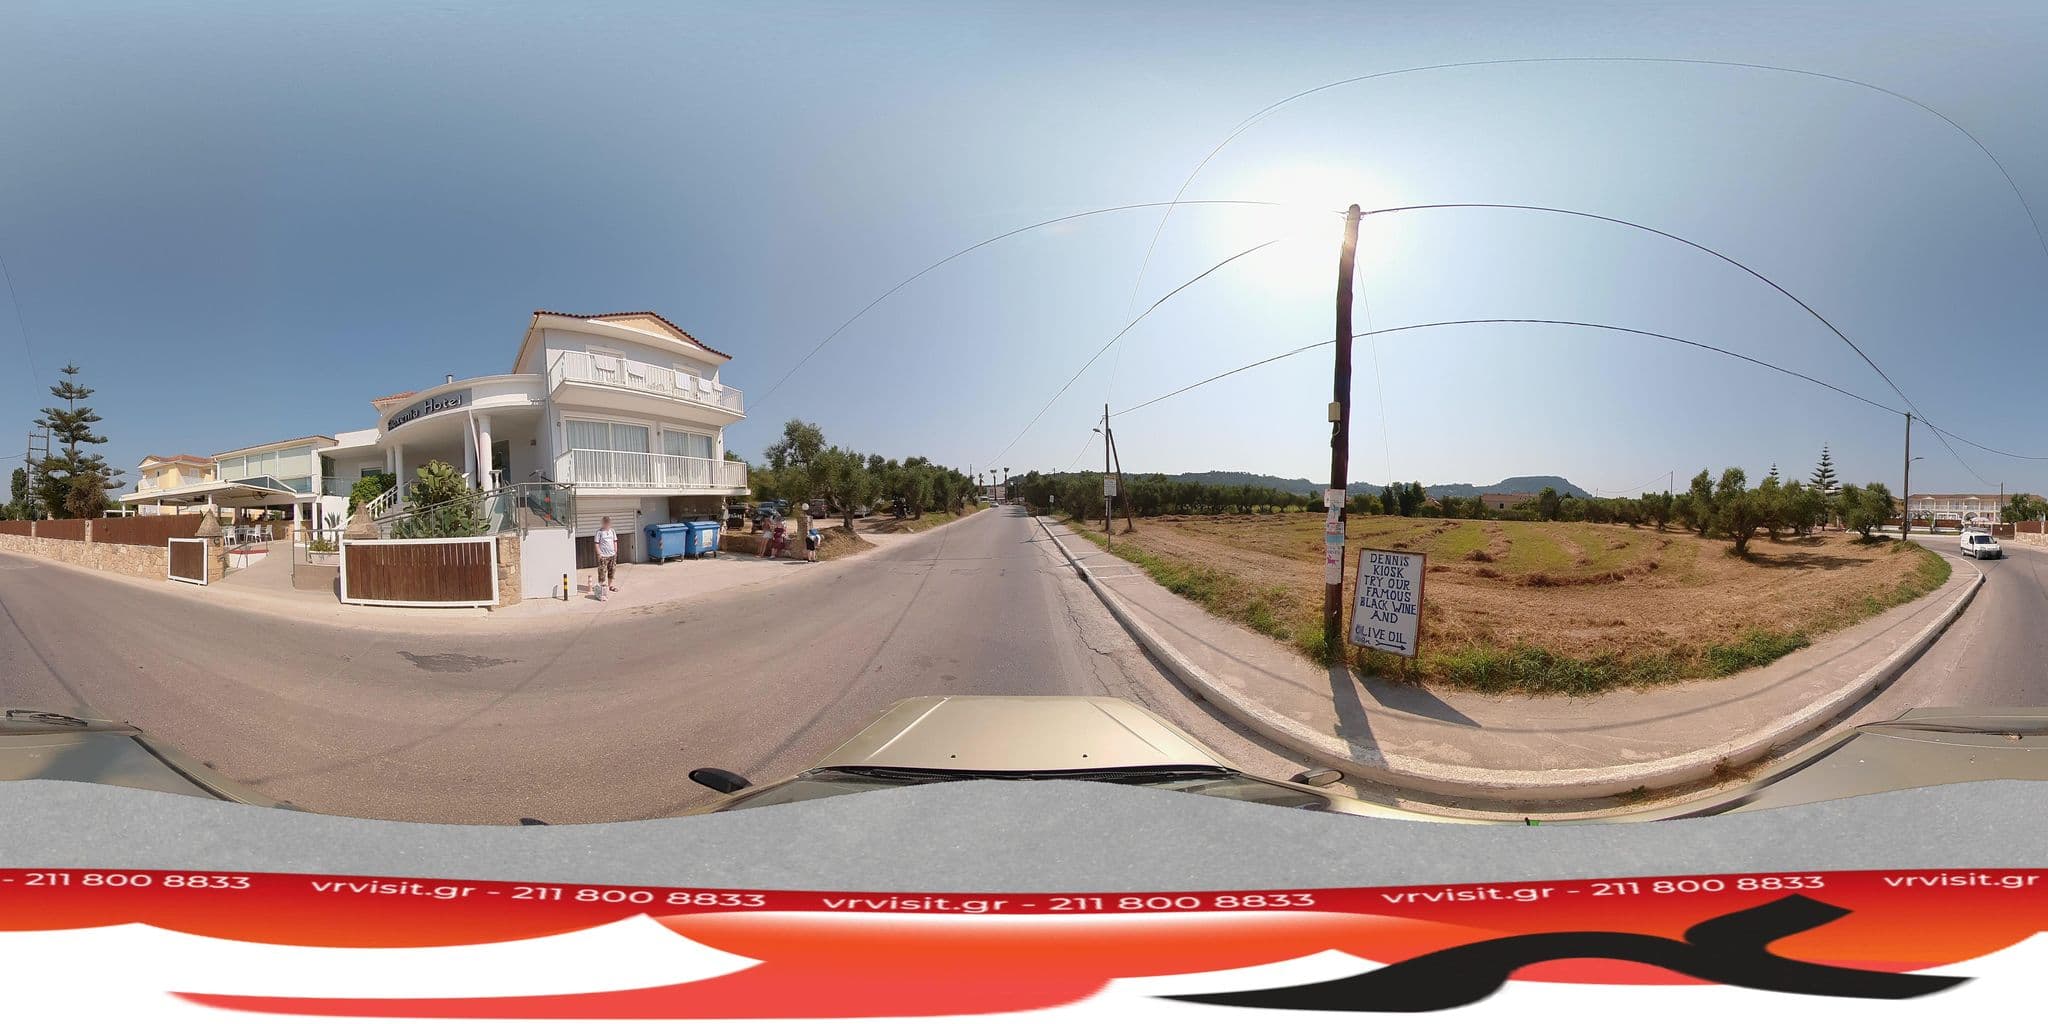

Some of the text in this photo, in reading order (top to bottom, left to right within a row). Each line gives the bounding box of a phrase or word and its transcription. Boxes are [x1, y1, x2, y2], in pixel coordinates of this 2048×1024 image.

[424, 394, 462, 414] Hotel
[1370, 553, 1410, 567] DENNIS
[1373, 564, 1404, 578] KIOSK
[1364, 575, 1410, 591] TRY OUR
[1366, 587, 1411, 602] FAMOUS
[1360, 596, 1417, 615] BLACK WINE
[1370, 610, 1399, 624] AND
[1356, 624, 1386, 640] OLIVE
[1388, 631, 1408, 644] OIL
